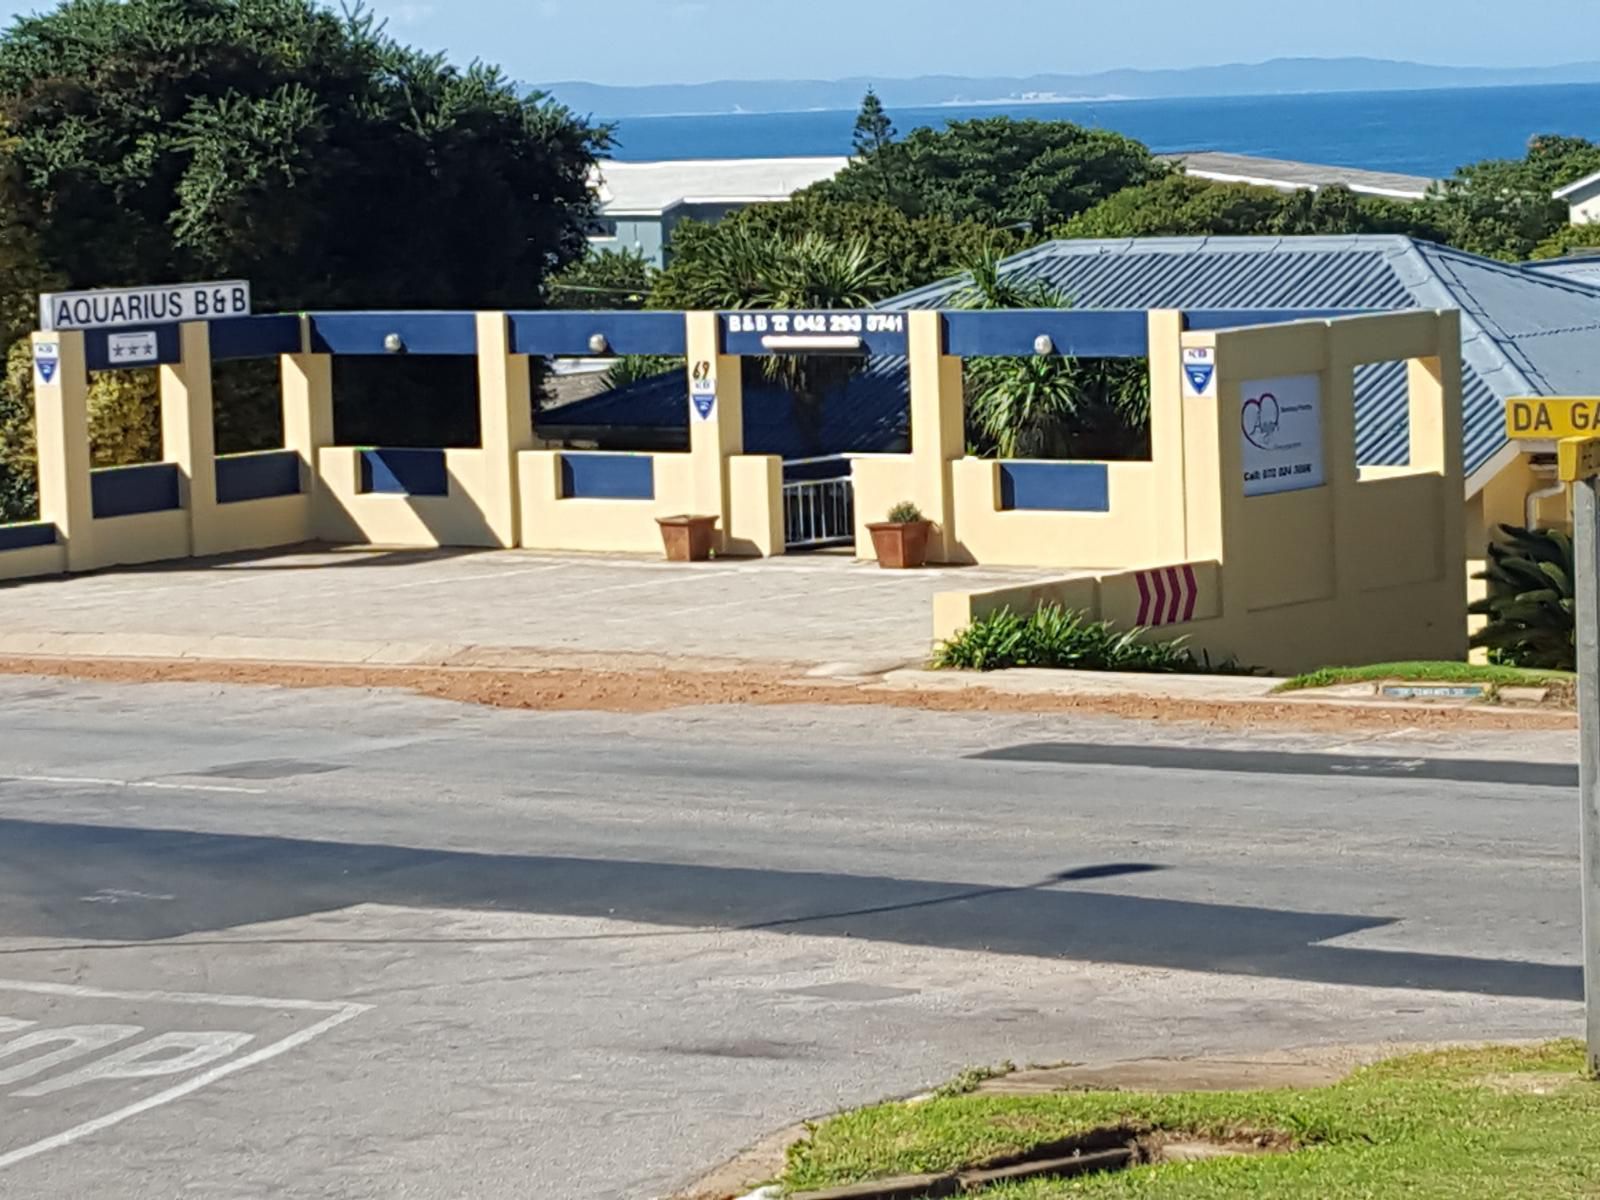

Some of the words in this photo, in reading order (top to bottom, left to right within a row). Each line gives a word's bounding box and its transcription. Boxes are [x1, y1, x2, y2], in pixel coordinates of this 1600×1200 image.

[56, 291, 183, 326] AQUARIUS
[194, 288, 246, 315] B&B
[728, 314, 768, 332] B&B
[692, 360, 710, 380] 69
[1513, 402, 1553, 431] DA
